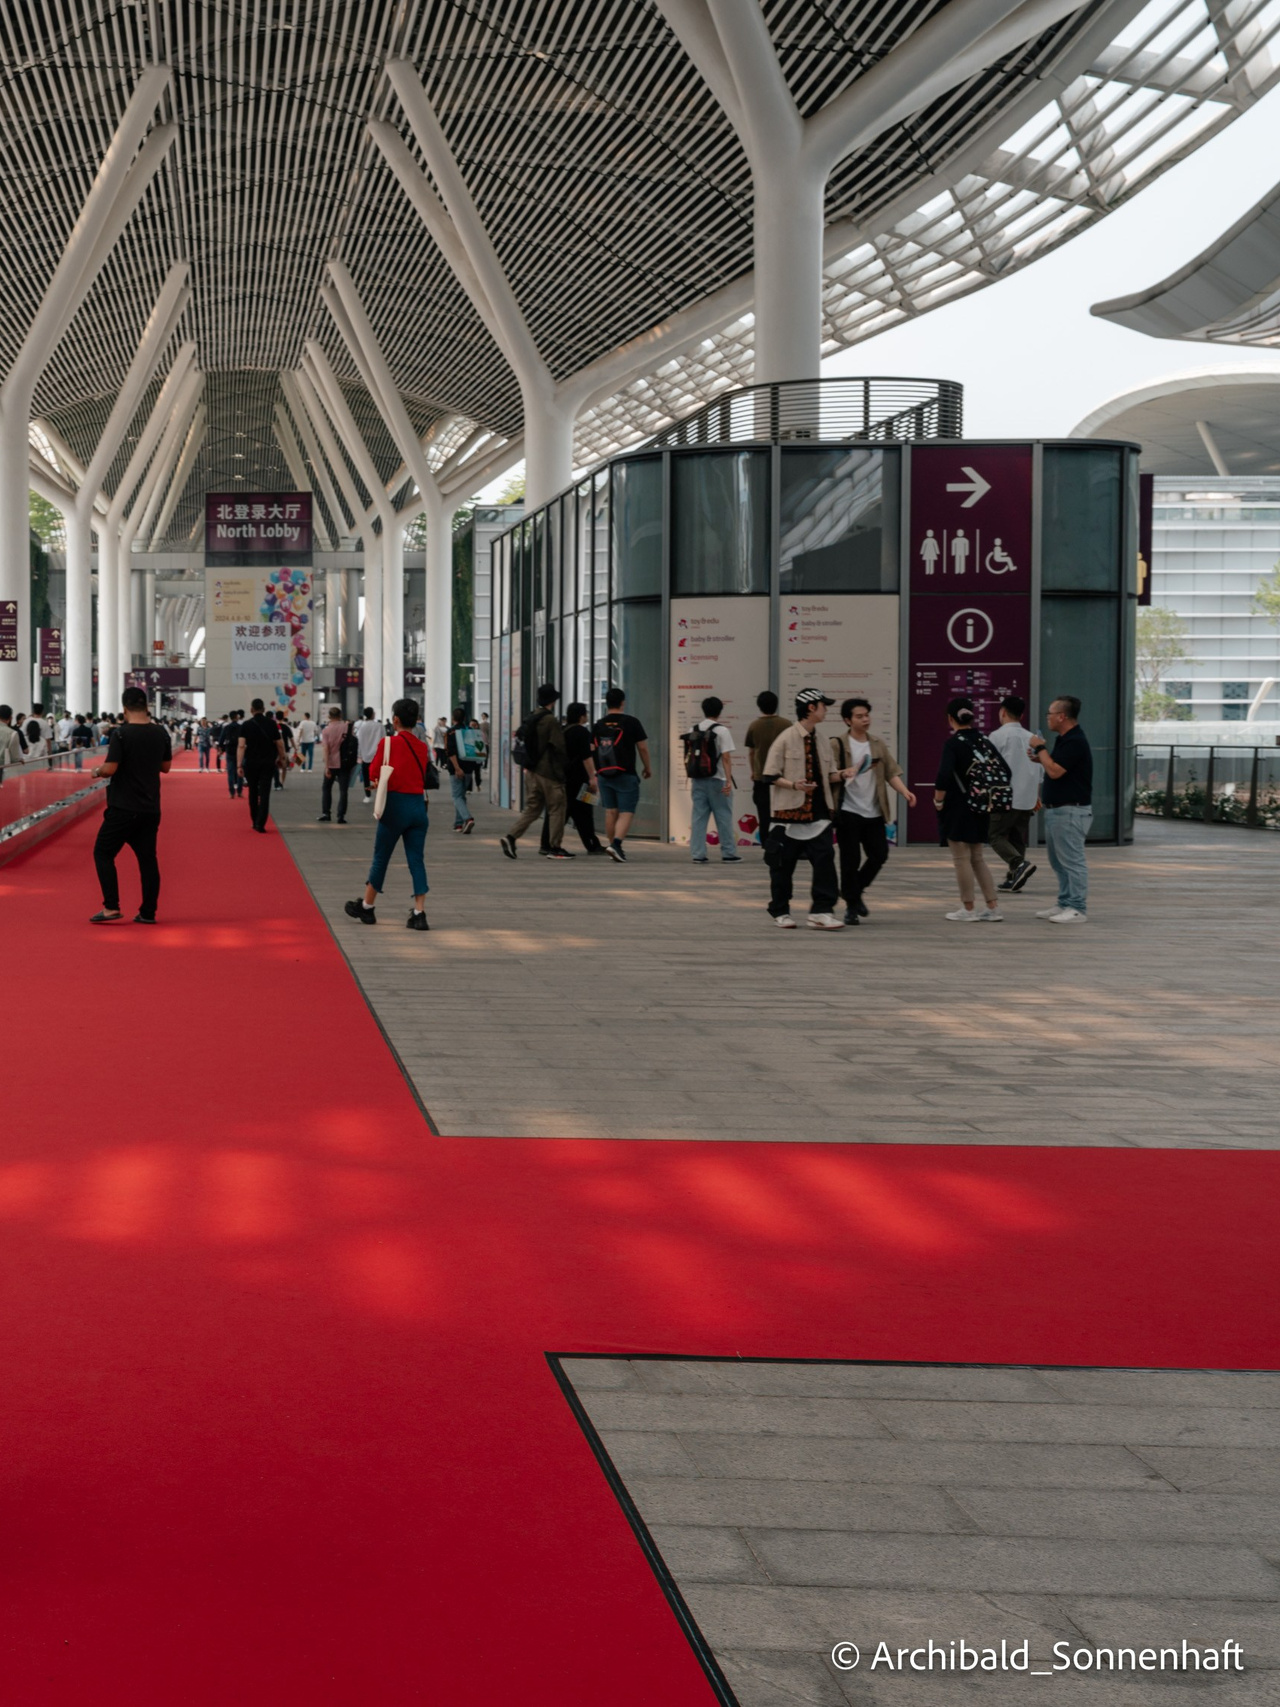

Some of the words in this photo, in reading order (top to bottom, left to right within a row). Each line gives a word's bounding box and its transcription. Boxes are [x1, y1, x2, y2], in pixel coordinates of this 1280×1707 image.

[216, 503, 301, 520] 北登录大厅
[216, 523, 257, 538] North
[260, 523, 300, 541] Lobby
[235, 625, 287, 637] 欢迎参观
[234, 640, 287, 651] Welcome
[42, 666, 60, 675] 17-20
